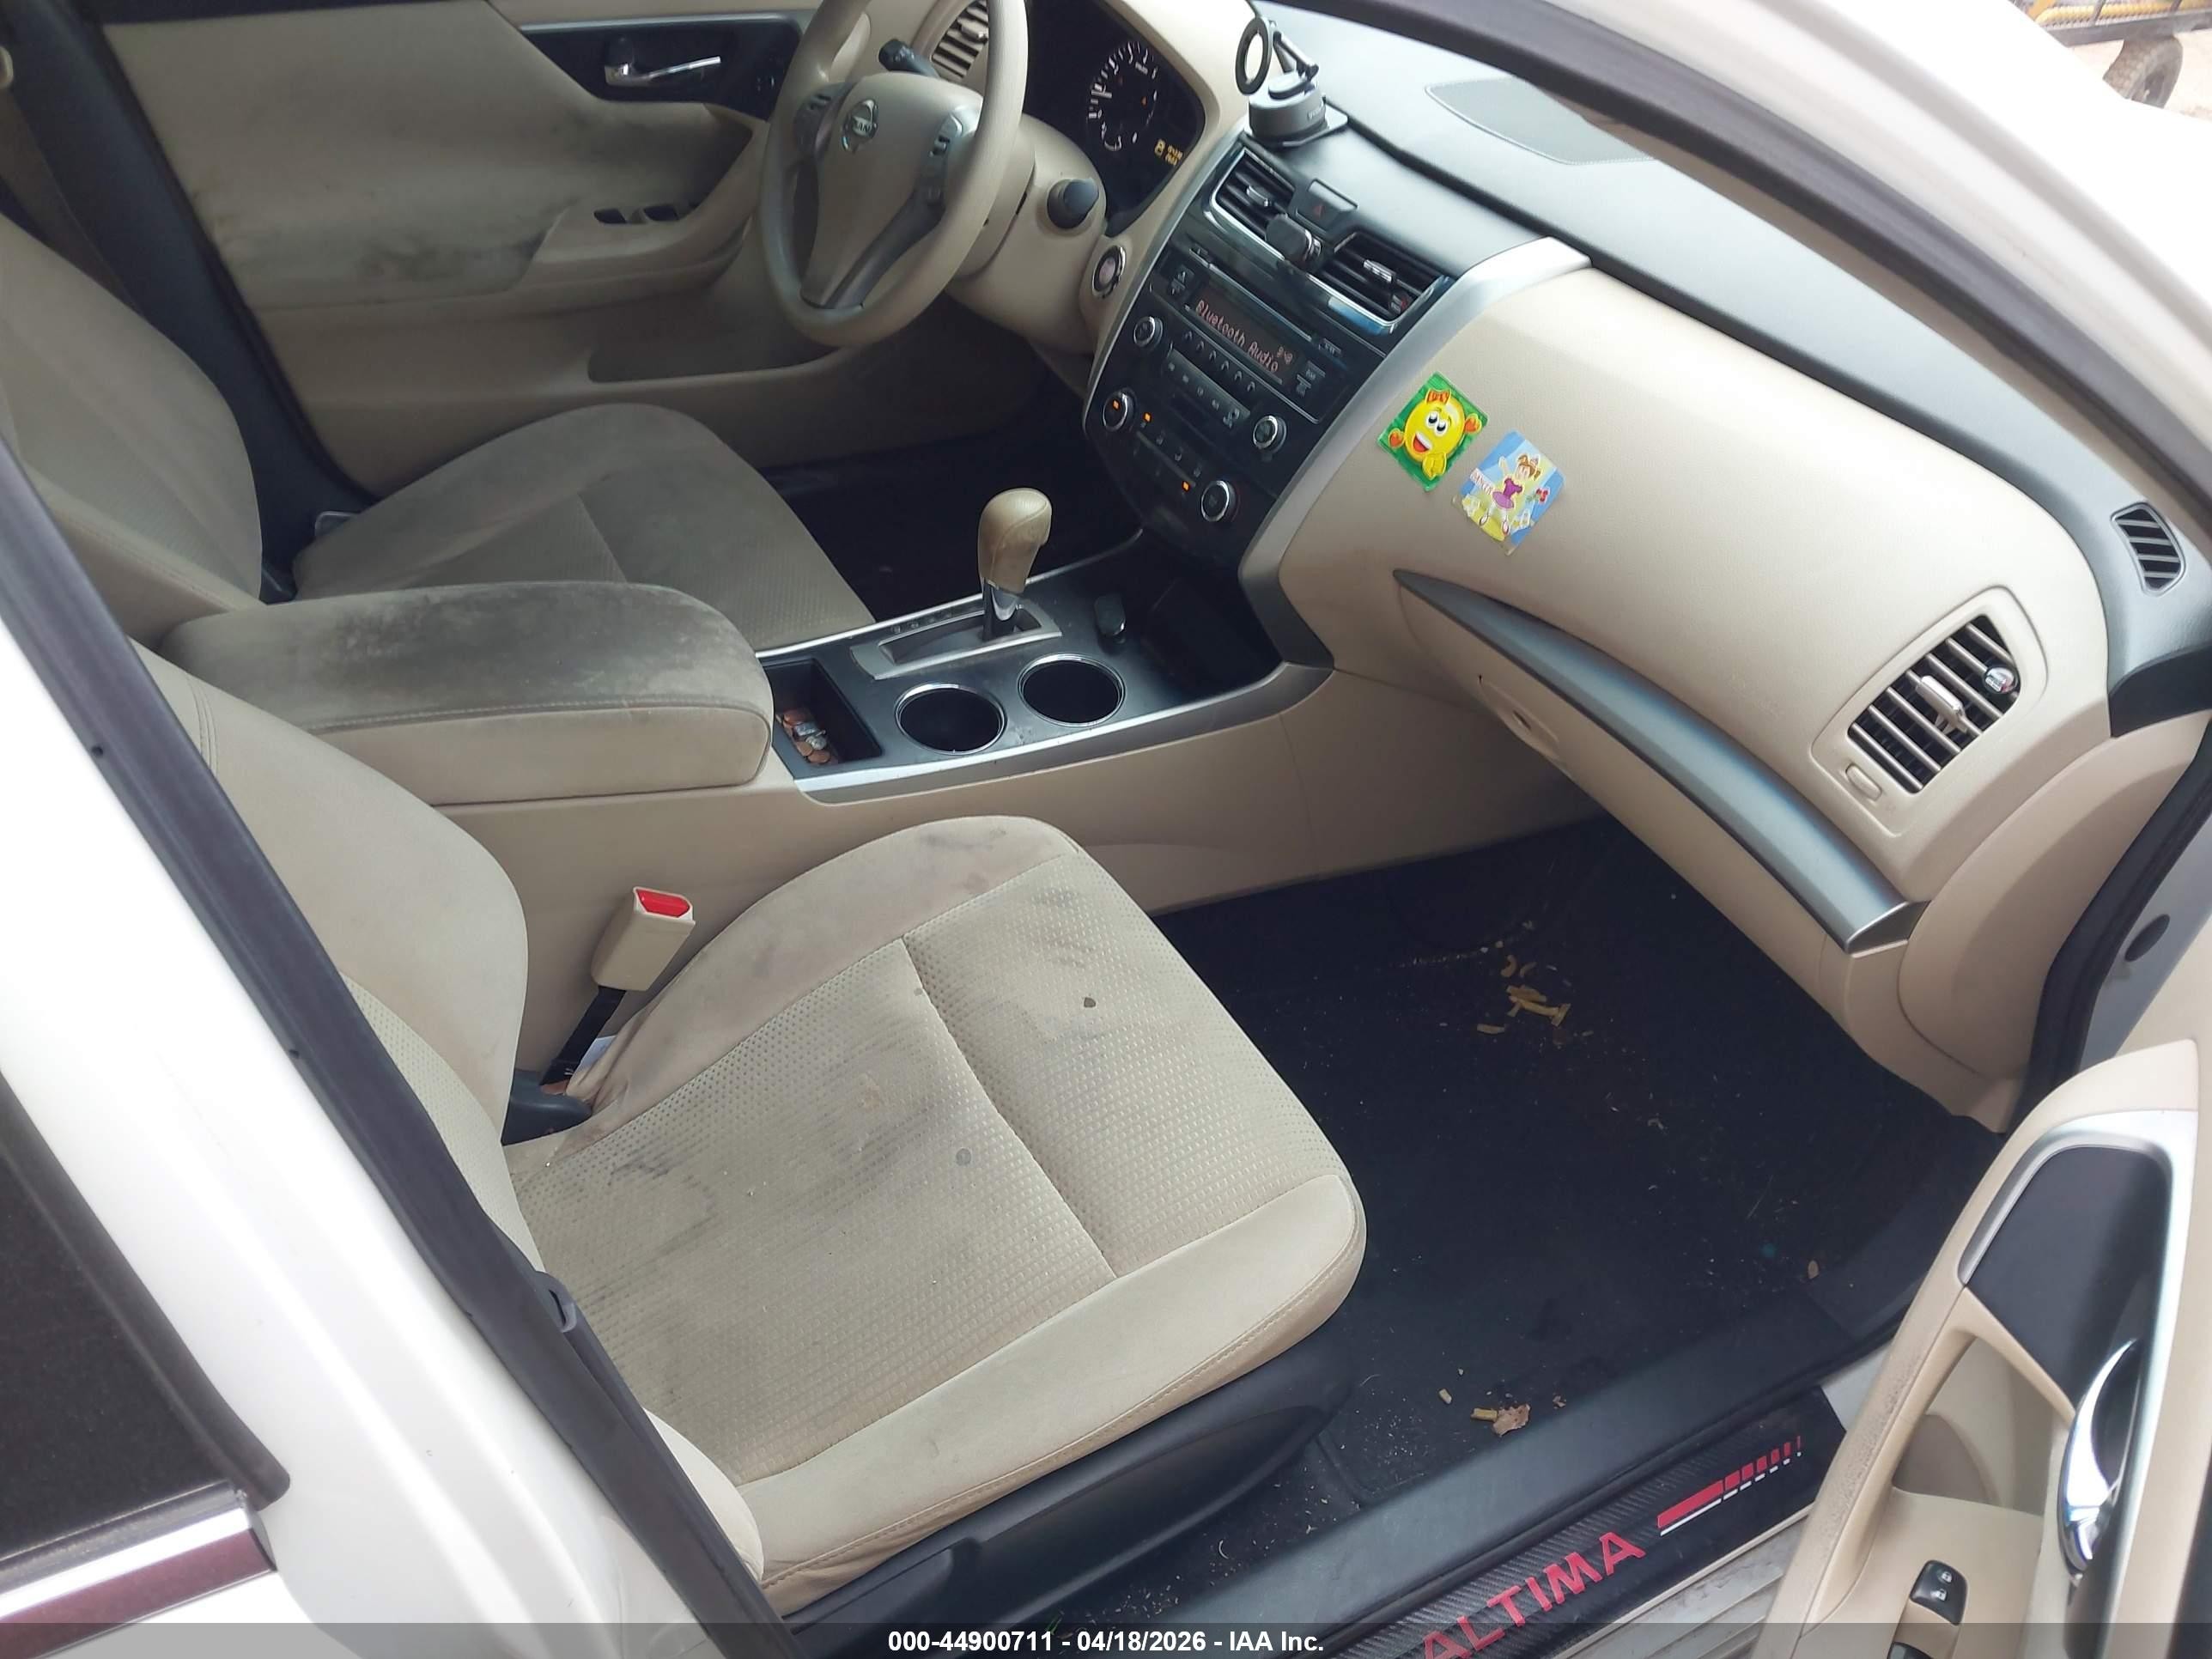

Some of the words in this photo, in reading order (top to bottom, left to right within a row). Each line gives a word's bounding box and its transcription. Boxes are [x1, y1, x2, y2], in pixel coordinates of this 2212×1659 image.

[1195, 299, 1246, 348] Bluetooth
[1248, 341, 1279, 374] Audio
[1424, 1531, 1646, 1659] ALTIMA
